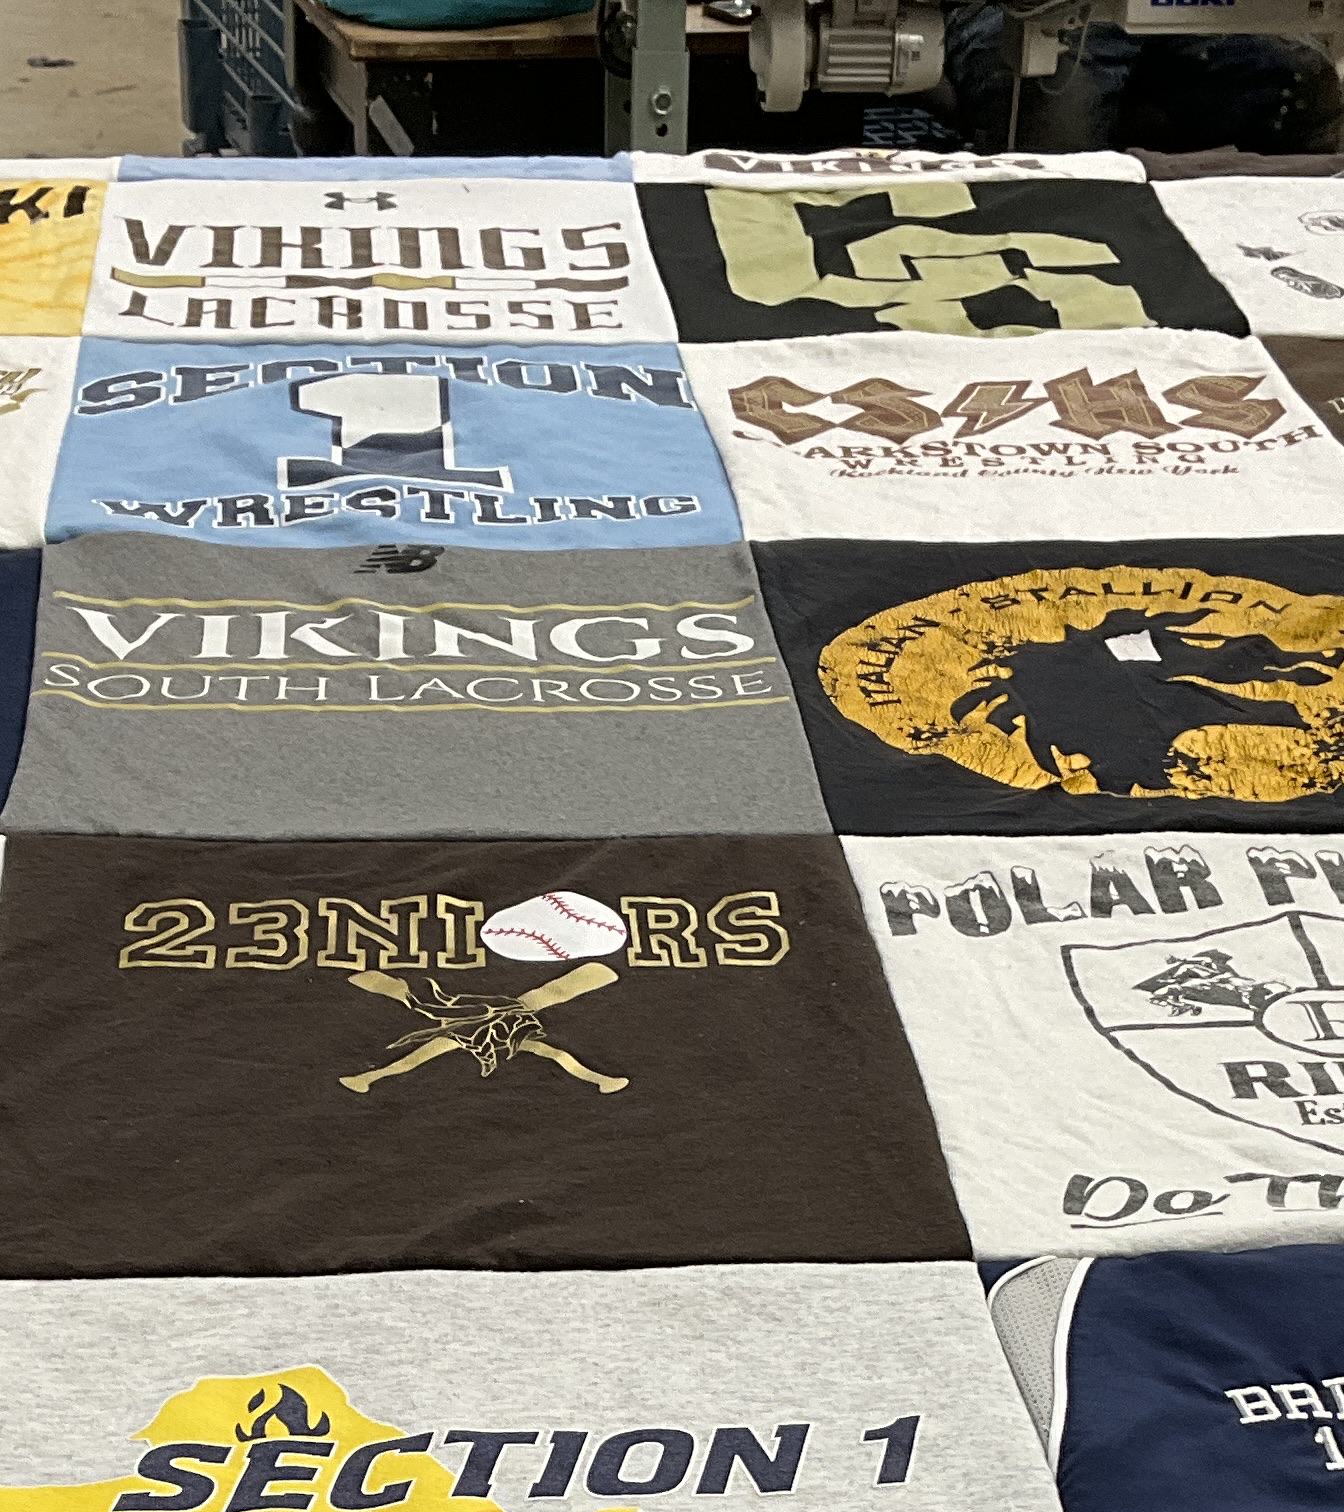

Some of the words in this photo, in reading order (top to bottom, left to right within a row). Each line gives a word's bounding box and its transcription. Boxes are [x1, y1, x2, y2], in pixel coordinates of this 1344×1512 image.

[118, 217, 630, 270] VIKINGS
[120, 291, 623, 330] LACROSSE
[74, 355, 696, 416] SECTION
[278, 372, 513, 493] 1
[1132, 425, 1324, 454] SOUTH
[842, 453, 1205, 470] WRESTLING
[93, 485, 702, 528] WRESTLING
[66, 605, 756, 662] VIKINGS
[42, 663, 329, 702] SOUTH
[368, 670, 774, 703] LACROSSE
[881, 845, 1223, 937] POLAR
[1062, 1174, 1232, 1222] Do
[860, 1413, 924, 1487] 1
